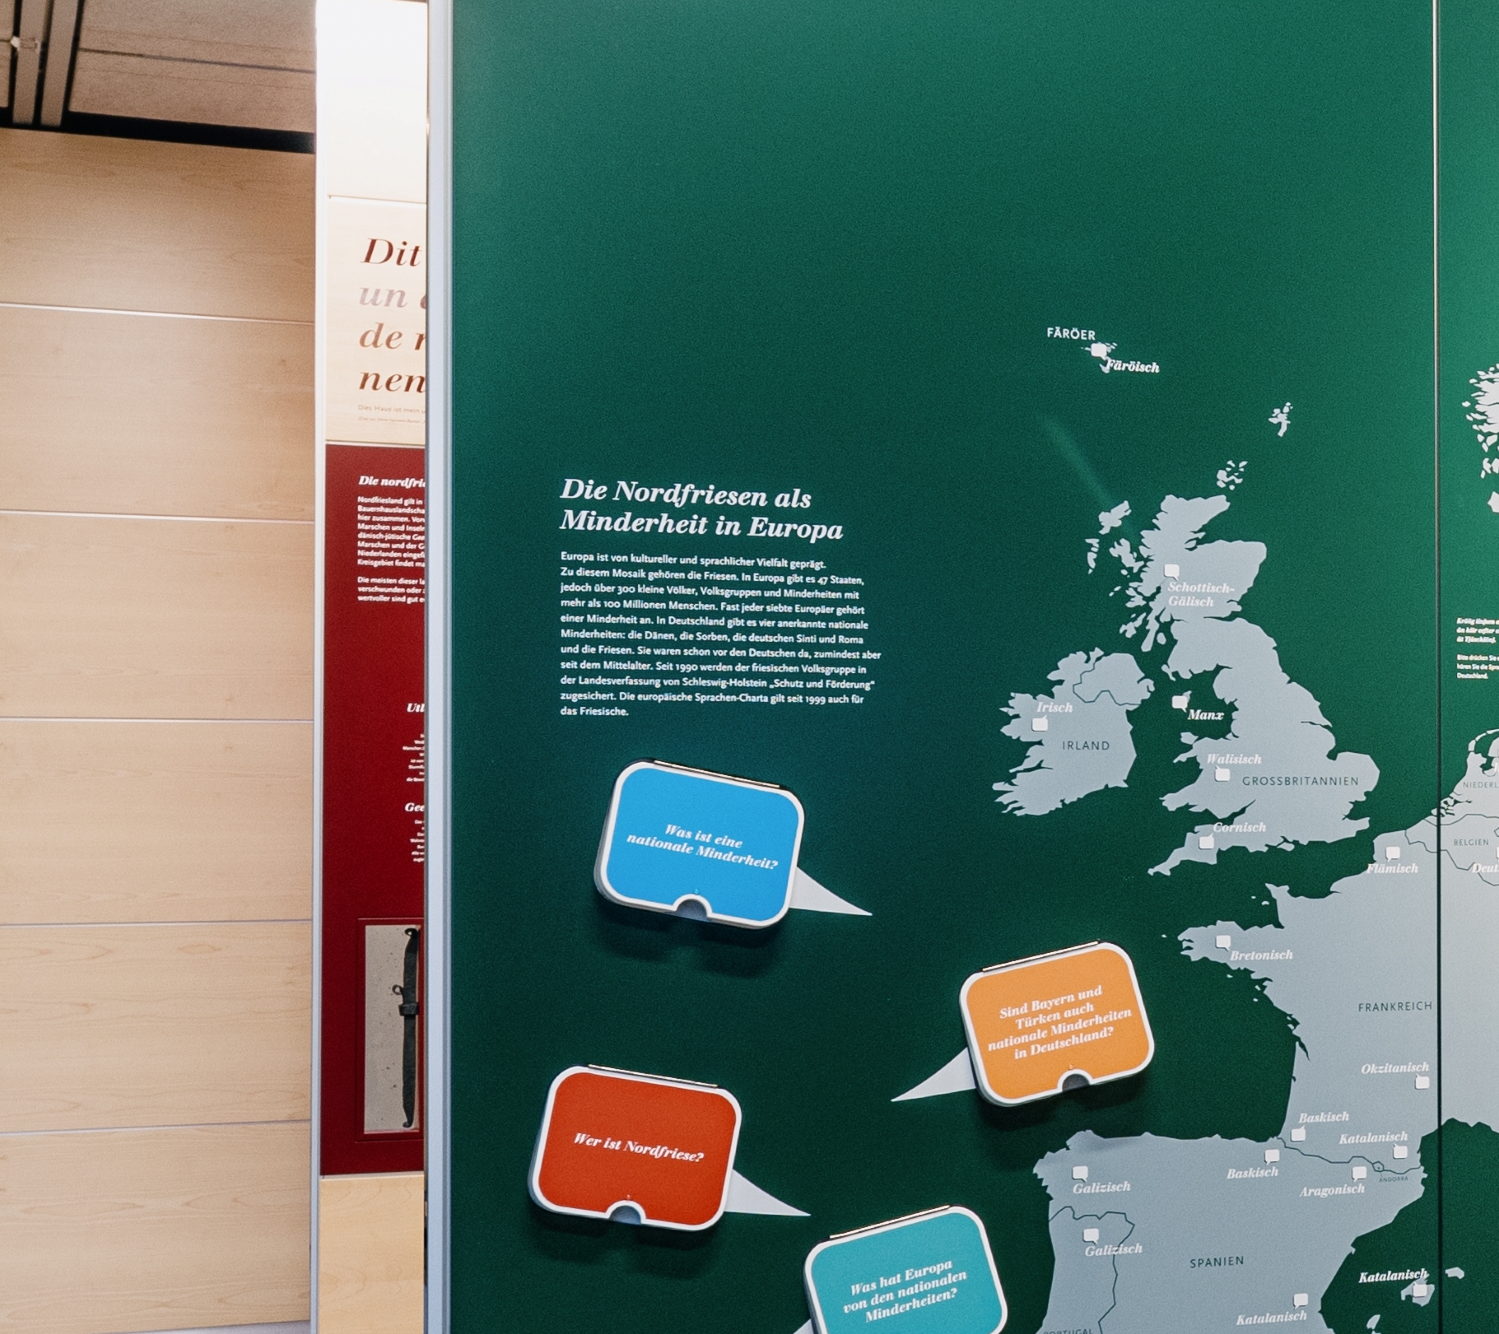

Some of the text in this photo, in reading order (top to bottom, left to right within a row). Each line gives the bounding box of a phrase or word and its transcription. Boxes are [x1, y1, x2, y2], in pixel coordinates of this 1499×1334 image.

[360, 237, 423, 267] Dit
[359, 287, 407, 308] un
[358, 322, 403, 349] de
[1047, 326, 1095, 341] FÄRÖER
[1106, 359, 1160, 374] Färöisch
[559, 478, 811, 508] Die Nordfriesen als
[559, 509, 843, 543] Minderheit in Europa
[560, 551, 826, 570] Europa ist von kultureller und sprachlicher Vielfalt geprägt.
[560, 566, 573, 575] Zu
[575, 566, 609, 576] diesem
[612, 568, 645, 577] Mosaik
[647, 569, 685, 581] gehören
[686, 570, 701, 579] die
[703, 571, 738, 580] Friesen.
[741, 572, 750, 580] In
[753, 572, 784, 584] Europa
[786, 573, 803, 585] gibt
[817, 576, 828, 584] 47
[829, 574, 864, 585] Staaten,
[1168, 582, 1235, 595] Schottisch-
[1168, 595, 1214, 608] Gälisch
[1036, 702, 1073, 714] Irisch
[1187, 710, 1224, 721] Manx
[1062, 741, 1110, 751] IRLAND
[1207, 754, 1262, 766] Walisisch
[1242, 775, 1360, 787] GROSSBRITANNIEN
[665, 824, 742, 848] Was ist eine
[1213, 822, 1267, 834] Cornisch
[626, 834, 778, 869] nationale Minderheit?
[1230, 950, 1293, 961] Bretonisch
[999, 984, 1102, 1018] Sind Bayern und
[1358, 1001, 1433, 1012] FRANKREICH
[1015, 1001, 1094, 1029] Türken auch
[988, 1009, 1131, 1051] nationale Minderheiten
[1014, 1026, 1113, 1059] in Deutschland?
[574, 1132, 704, 1162] Wer ist Nordfriese?
[1073, 1180, 1131, 1195] Galizisch
[1190, 1256, 1244, 1269] SPANIEN
[851, 1260, 952, 1295] Was hat Europa
[843, 1271, 966, 1313] von den nationalen
[865, 1287, 957, 1322] Minderheiten?
